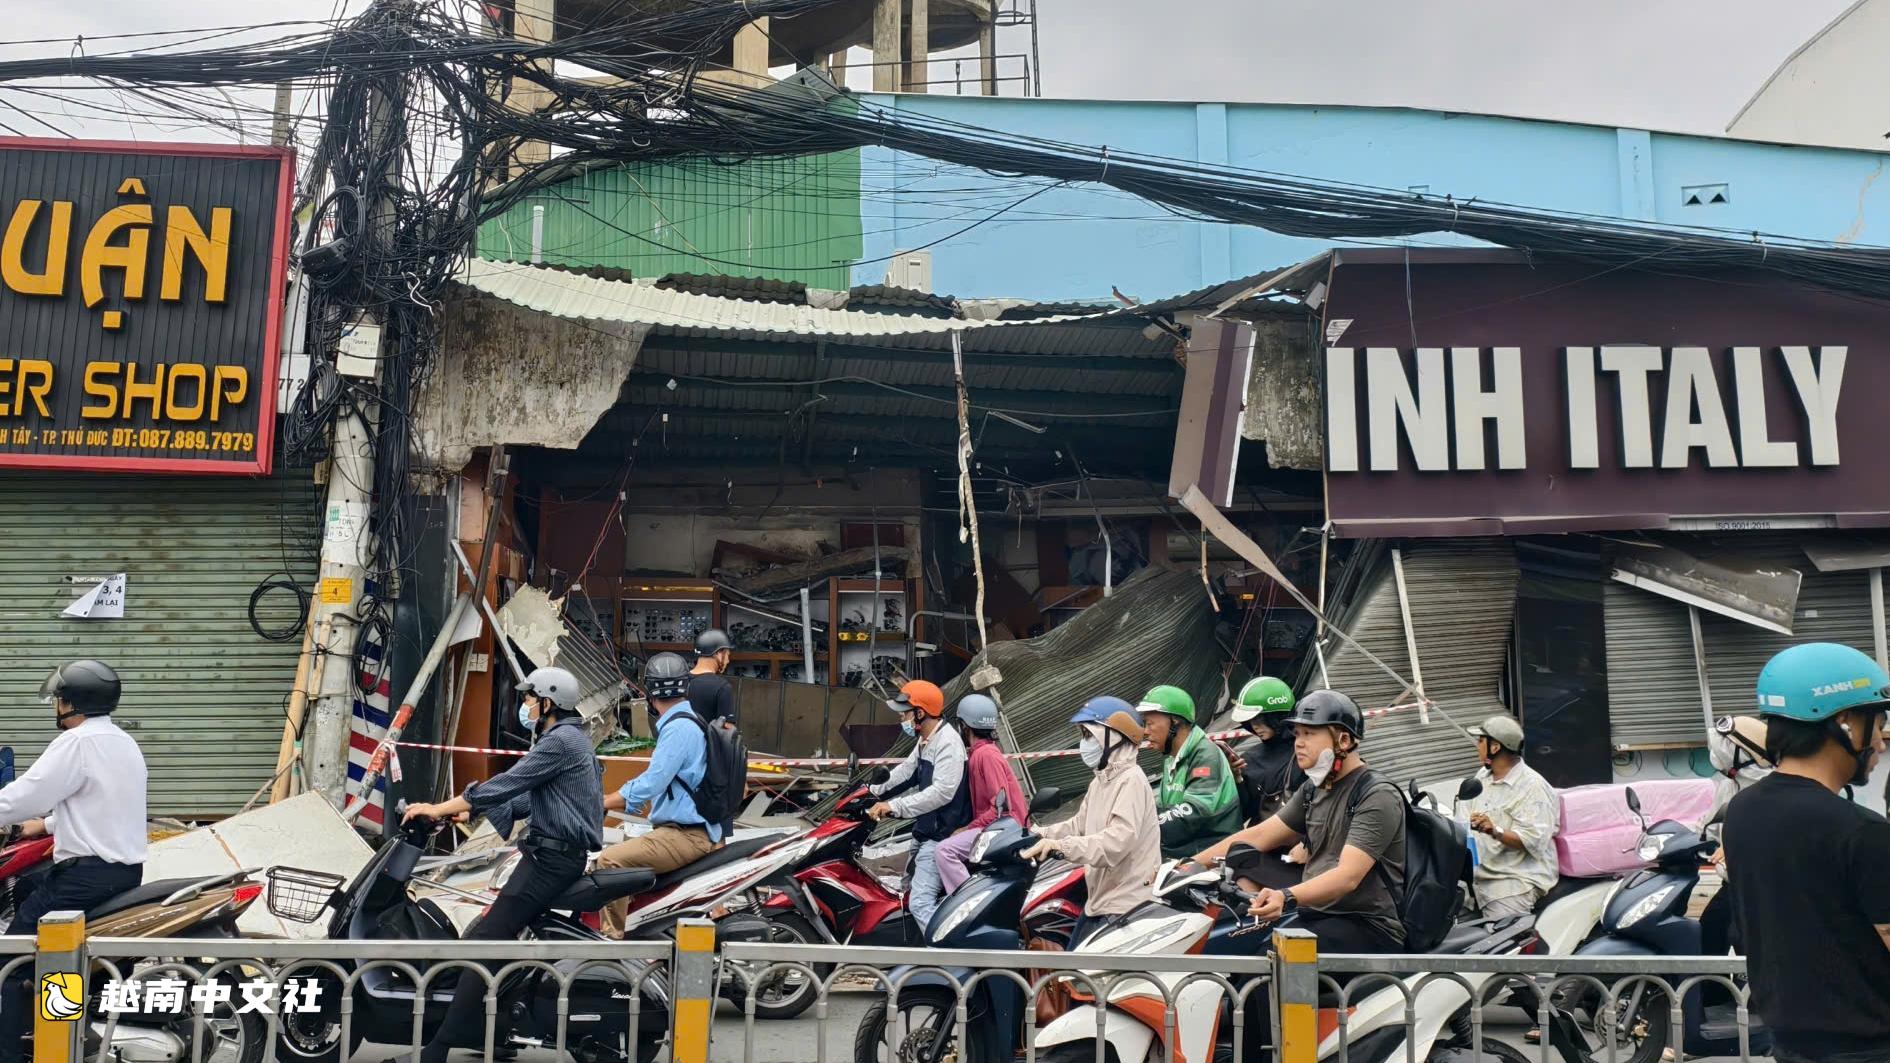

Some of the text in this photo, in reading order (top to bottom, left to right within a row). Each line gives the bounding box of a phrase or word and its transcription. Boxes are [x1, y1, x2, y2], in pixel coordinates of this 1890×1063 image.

[1, 177, 232, 328] UẬN
[82, 361, 248, 421] SHOP
[1567, 346, 1849, 468] ITALY
[102, 585, 122, 597] 3, 4
[1267, 695, 1289, 705] Grab
[1811, 680, 1853, 697] XANH
